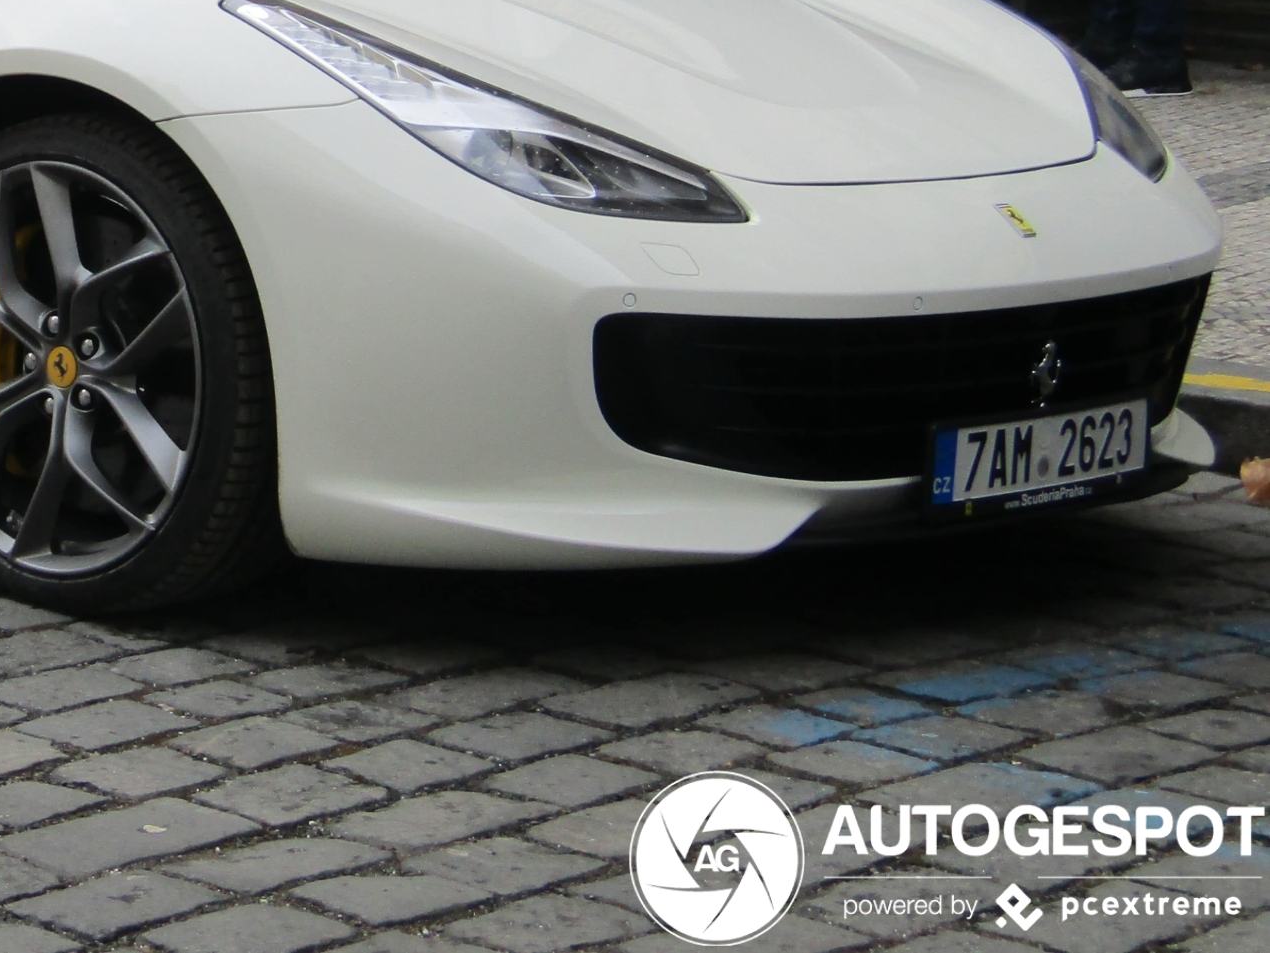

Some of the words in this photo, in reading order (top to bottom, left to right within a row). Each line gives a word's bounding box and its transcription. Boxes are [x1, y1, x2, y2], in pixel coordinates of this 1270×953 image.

[964, 424, 1034, 492] 7AM
[1057, 408, 1133, 478] 2623
[933, 476, 951, 495] CZ
